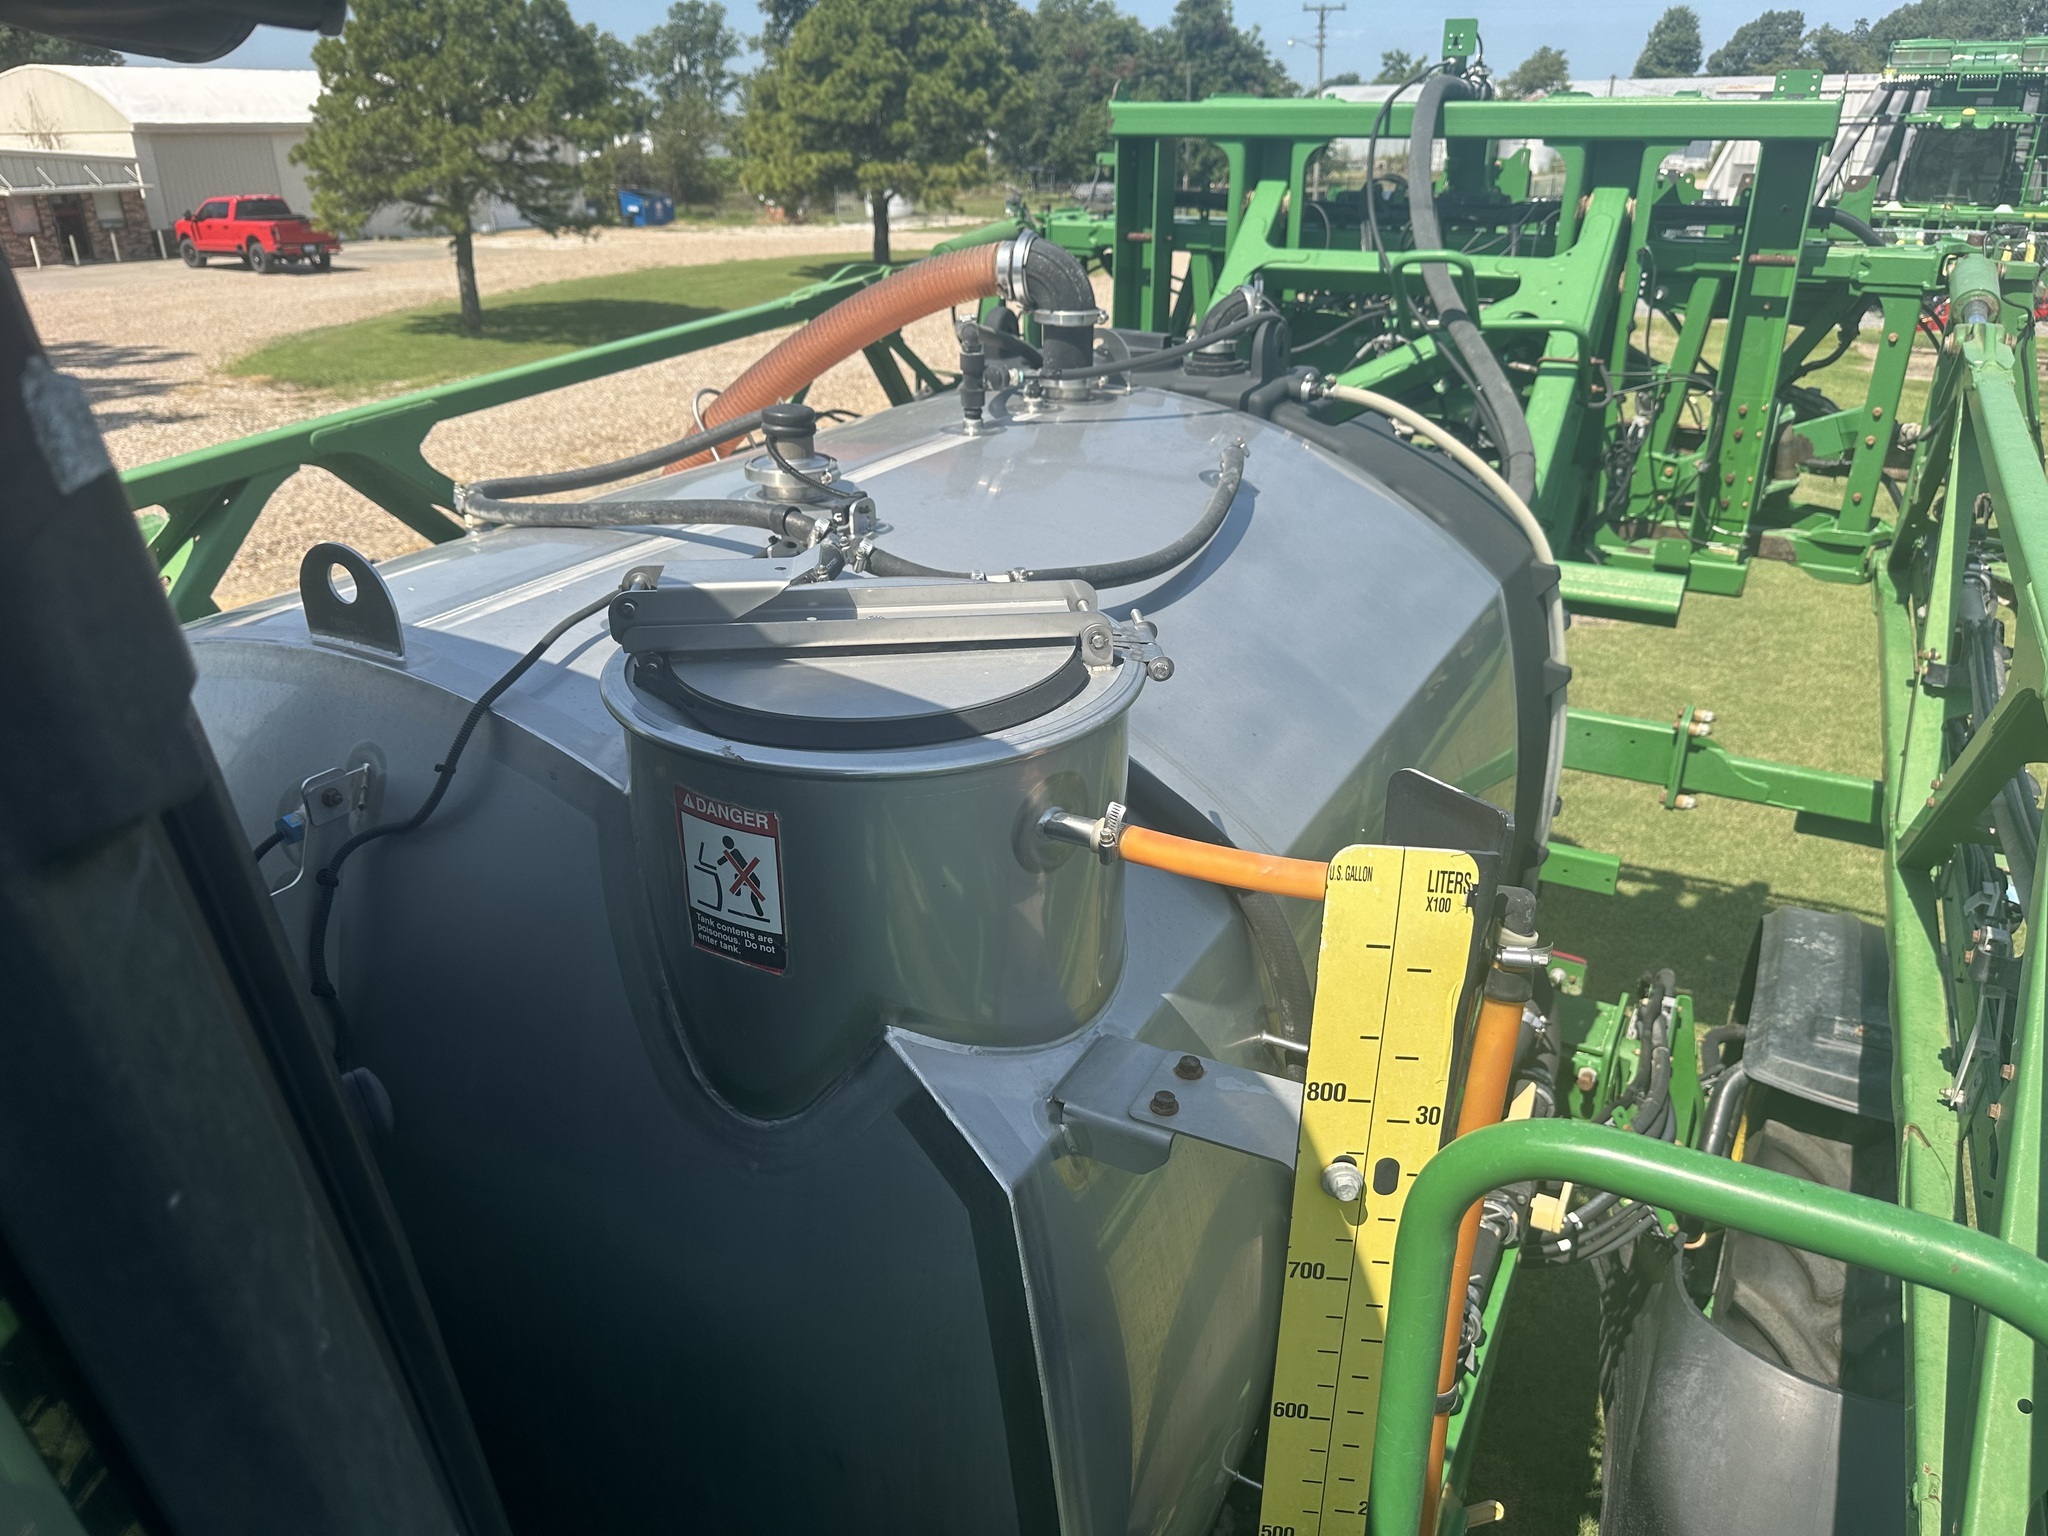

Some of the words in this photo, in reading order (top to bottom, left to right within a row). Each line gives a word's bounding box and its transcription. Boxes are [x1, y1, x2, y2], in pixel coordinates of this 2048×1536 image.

[696, 797, 769, 830] DANGER
[1329, 865, 1343, 881] U.S.
[1345, 865, 1373, 882] GALLON
[1427, 869, 1472, 894] LITERS
[1425, 896, 1452, 913] X100
[695, 911, 715, 927] Tank
[716, 922, 755, 940] contents
[757, 934, 774, 944] are
[697, 923, 741, 945] poisonous.
[744, 938, 758, 949] Do
[759, 944, 776, 954] not
[698, 932, 718, 946] enter
[719, 939, 742, 954] tank.
[1306, 1082, 1347, 1102] 800
[1415, 1106, 1441, 1125] 30
[1288, 1261, 1325, 1280] 700
[1273, 1401, 1309, 1419] 600
[1357, 1500, 1368, 1516] 2
